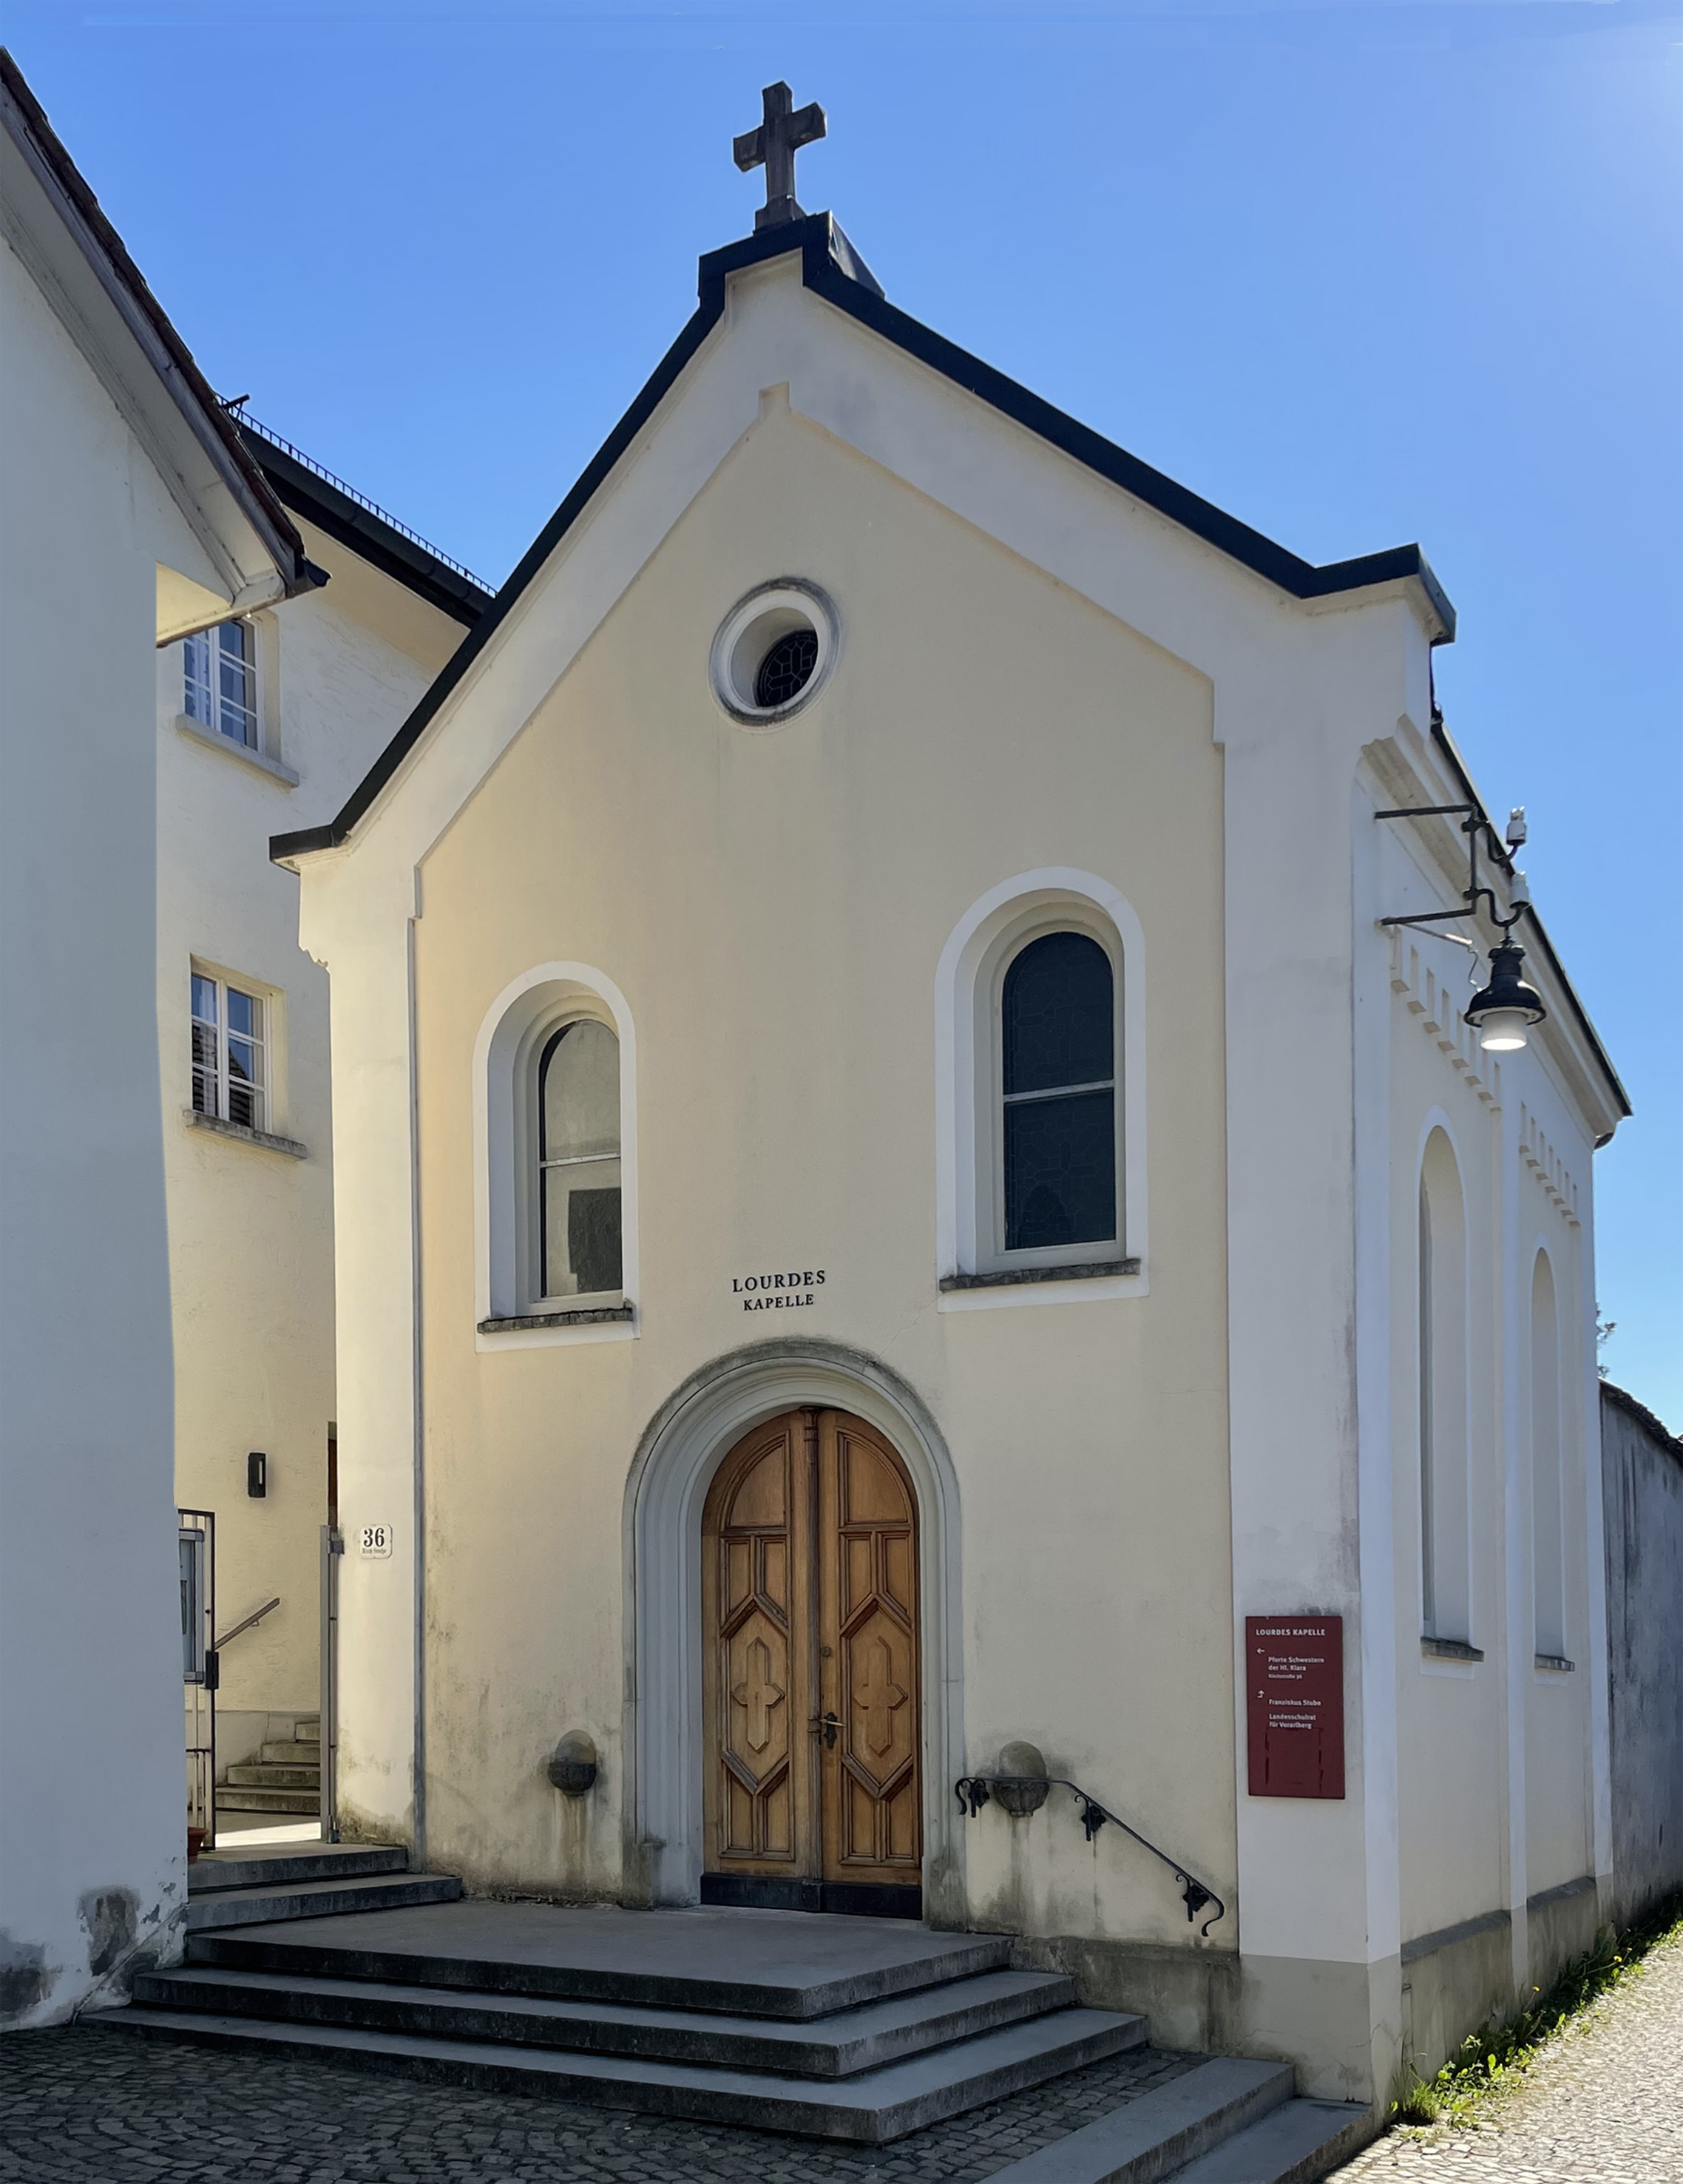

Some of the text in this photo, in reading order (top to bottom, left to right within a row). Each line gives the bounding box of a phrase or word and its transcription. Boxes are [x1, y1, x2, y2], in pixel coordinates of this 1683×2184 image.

[732, 1270, 825, 1292] LOURDES
[744, 1294, 813, 1311] KAPELLE
[363, 1527, 385, 1547] 36
